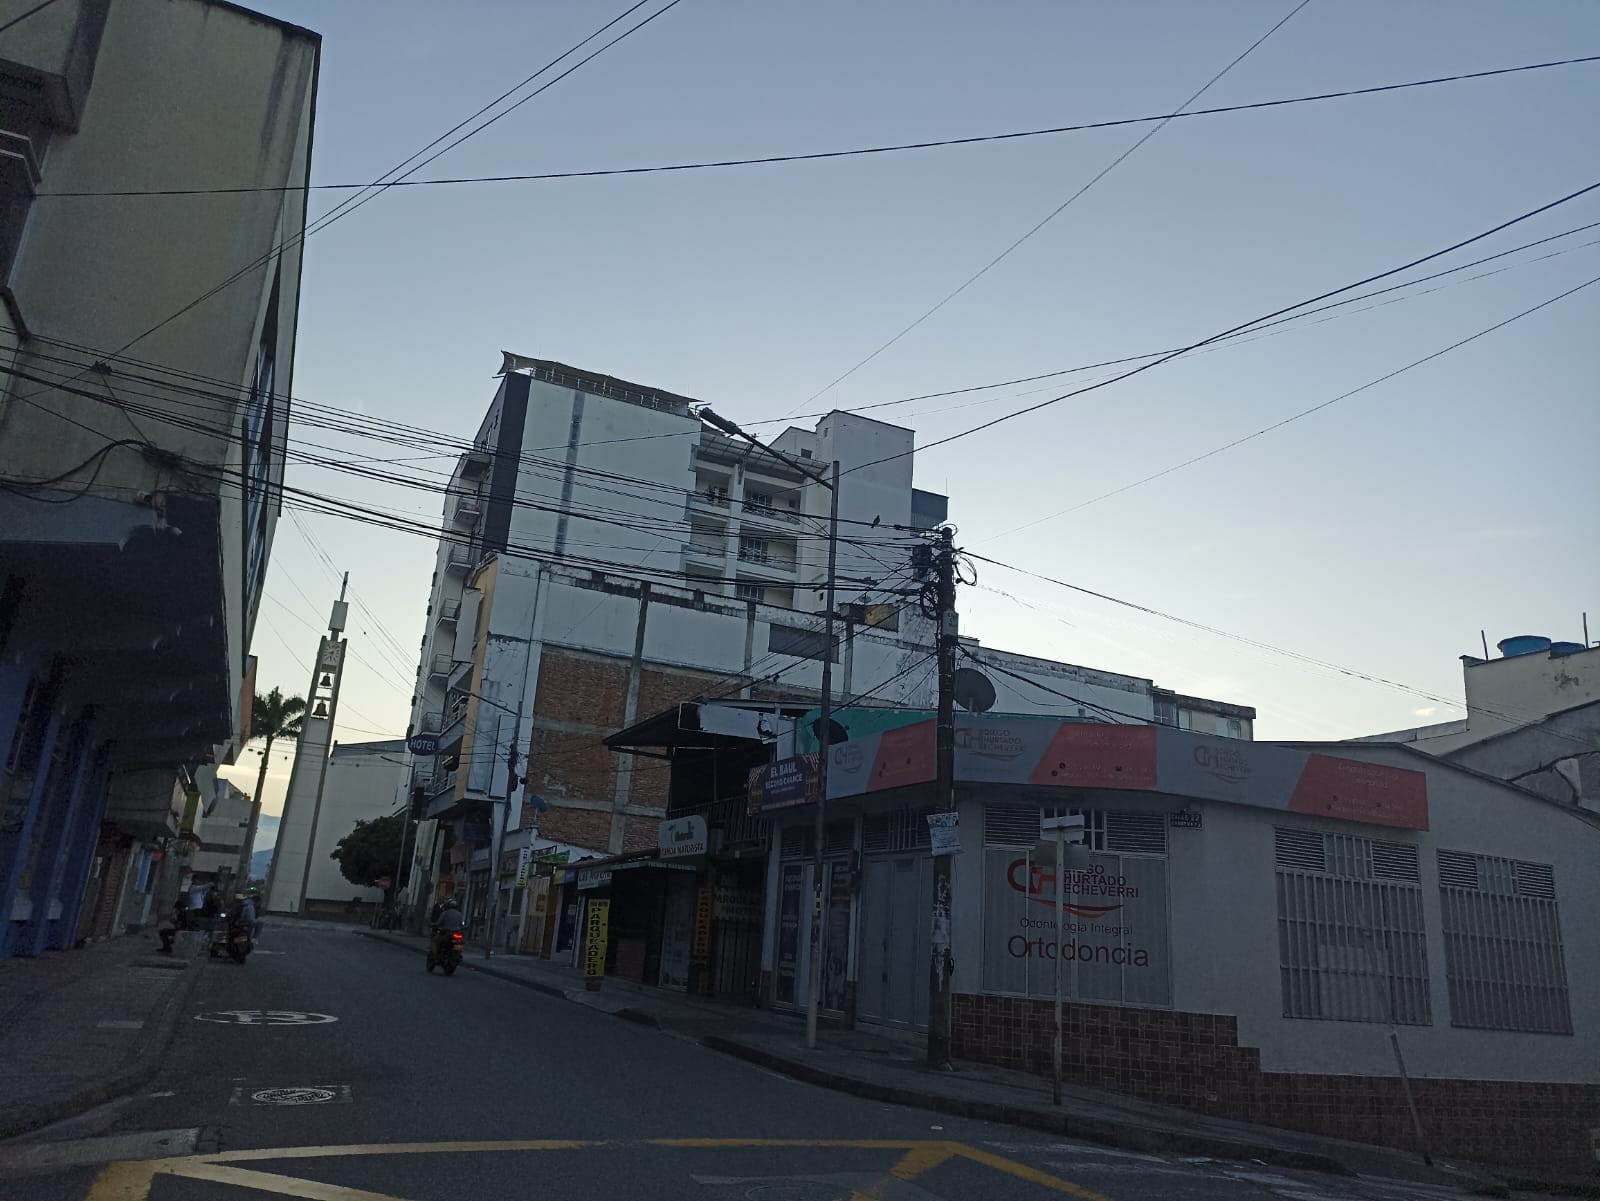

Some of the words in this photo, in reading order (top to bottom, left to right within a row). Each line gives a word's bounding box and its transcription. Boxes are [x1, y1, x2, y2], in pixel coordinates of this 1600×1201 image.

[410, 739, 437, 751] HOTEL
[771, 767, 778, 778] EL
[1064, 872, 1126, 886] HURTADO
[1064, 884, 1139, 898] ECHEVERRI
[1092, 922, 1133, 937] Integral
[587, 907, 601, 976] PARQUEADERO
[1008, 935, 1149, 967] Ortodoncia
